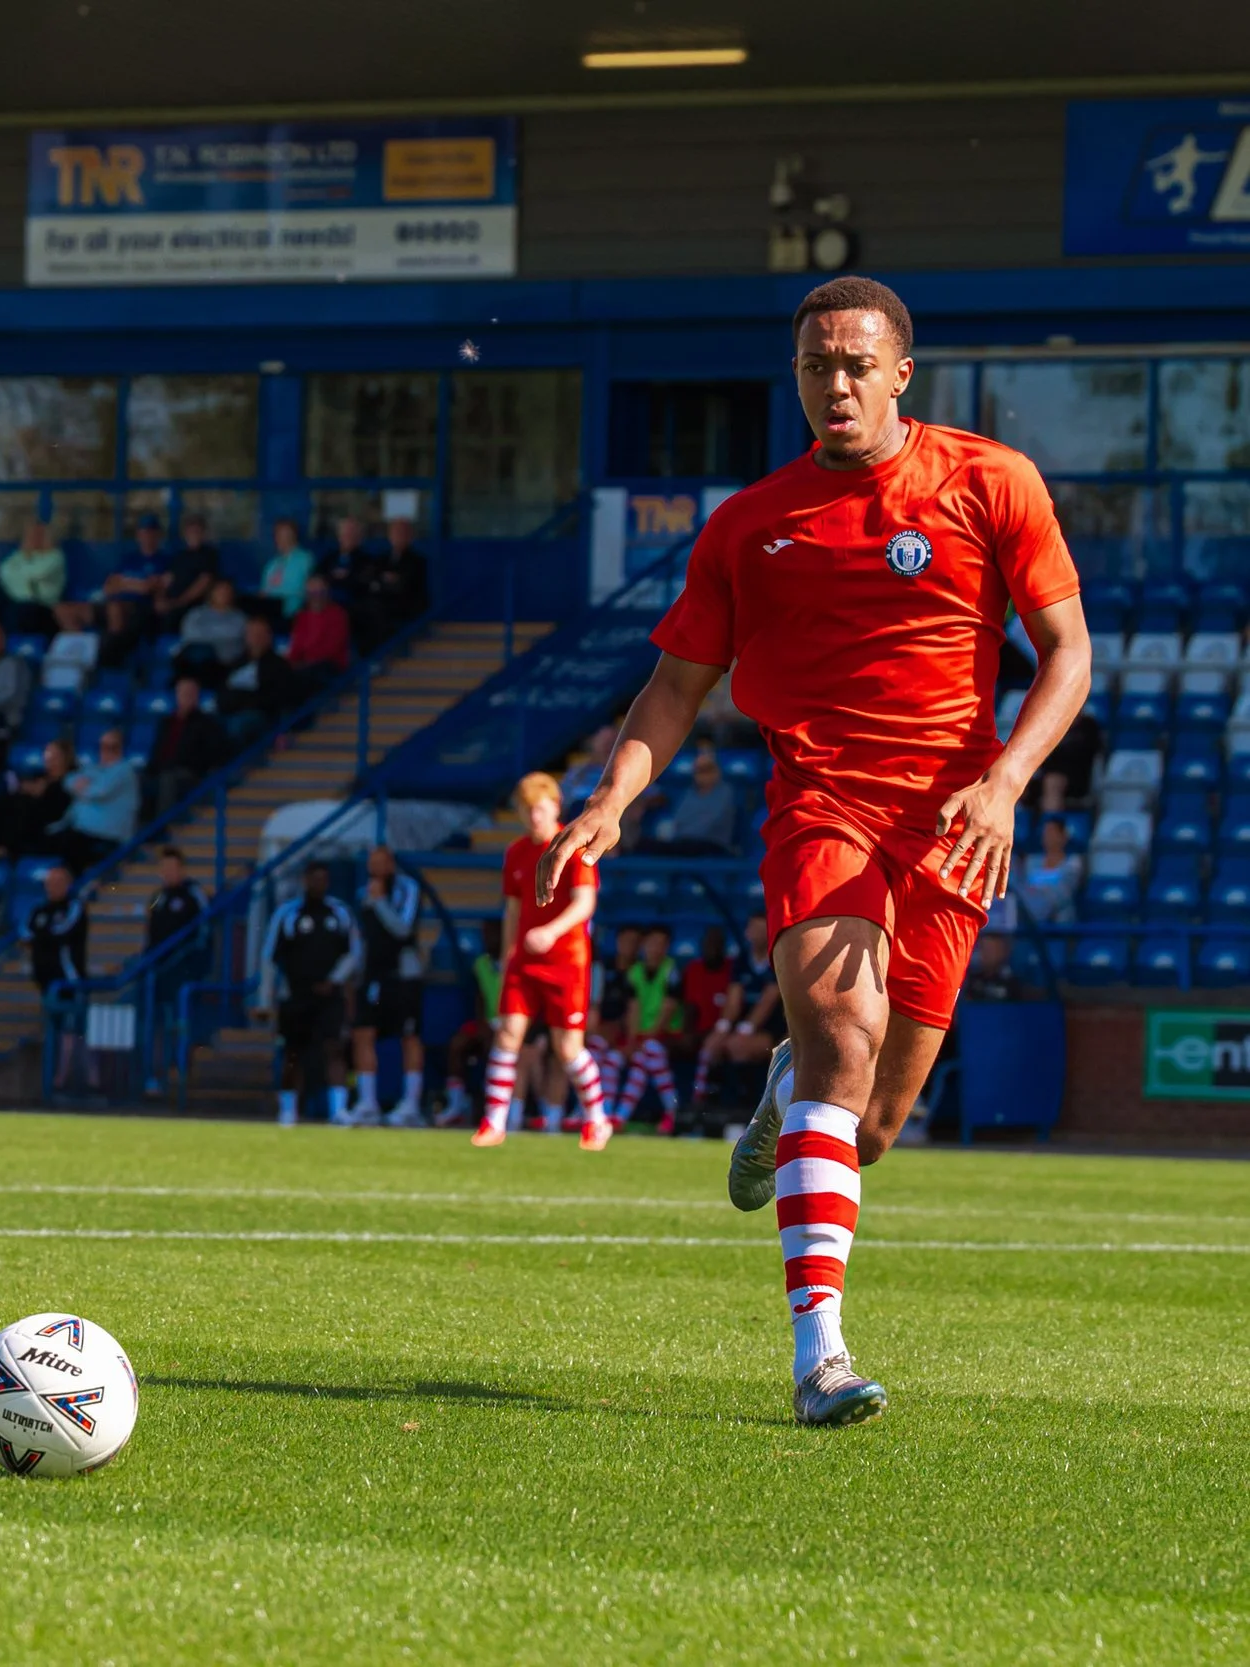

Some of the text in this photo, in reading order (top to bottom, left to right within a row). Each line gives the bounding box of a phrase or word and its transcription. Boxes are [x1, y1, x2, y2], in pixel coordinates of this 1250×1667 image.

[49, 144, 146, 206] TNR
[917, 534, 932, 550] TOWN
[17, 1347, 83, 1377] Mitre
[2, 1408, 55, 1433] ULTIMATCH
